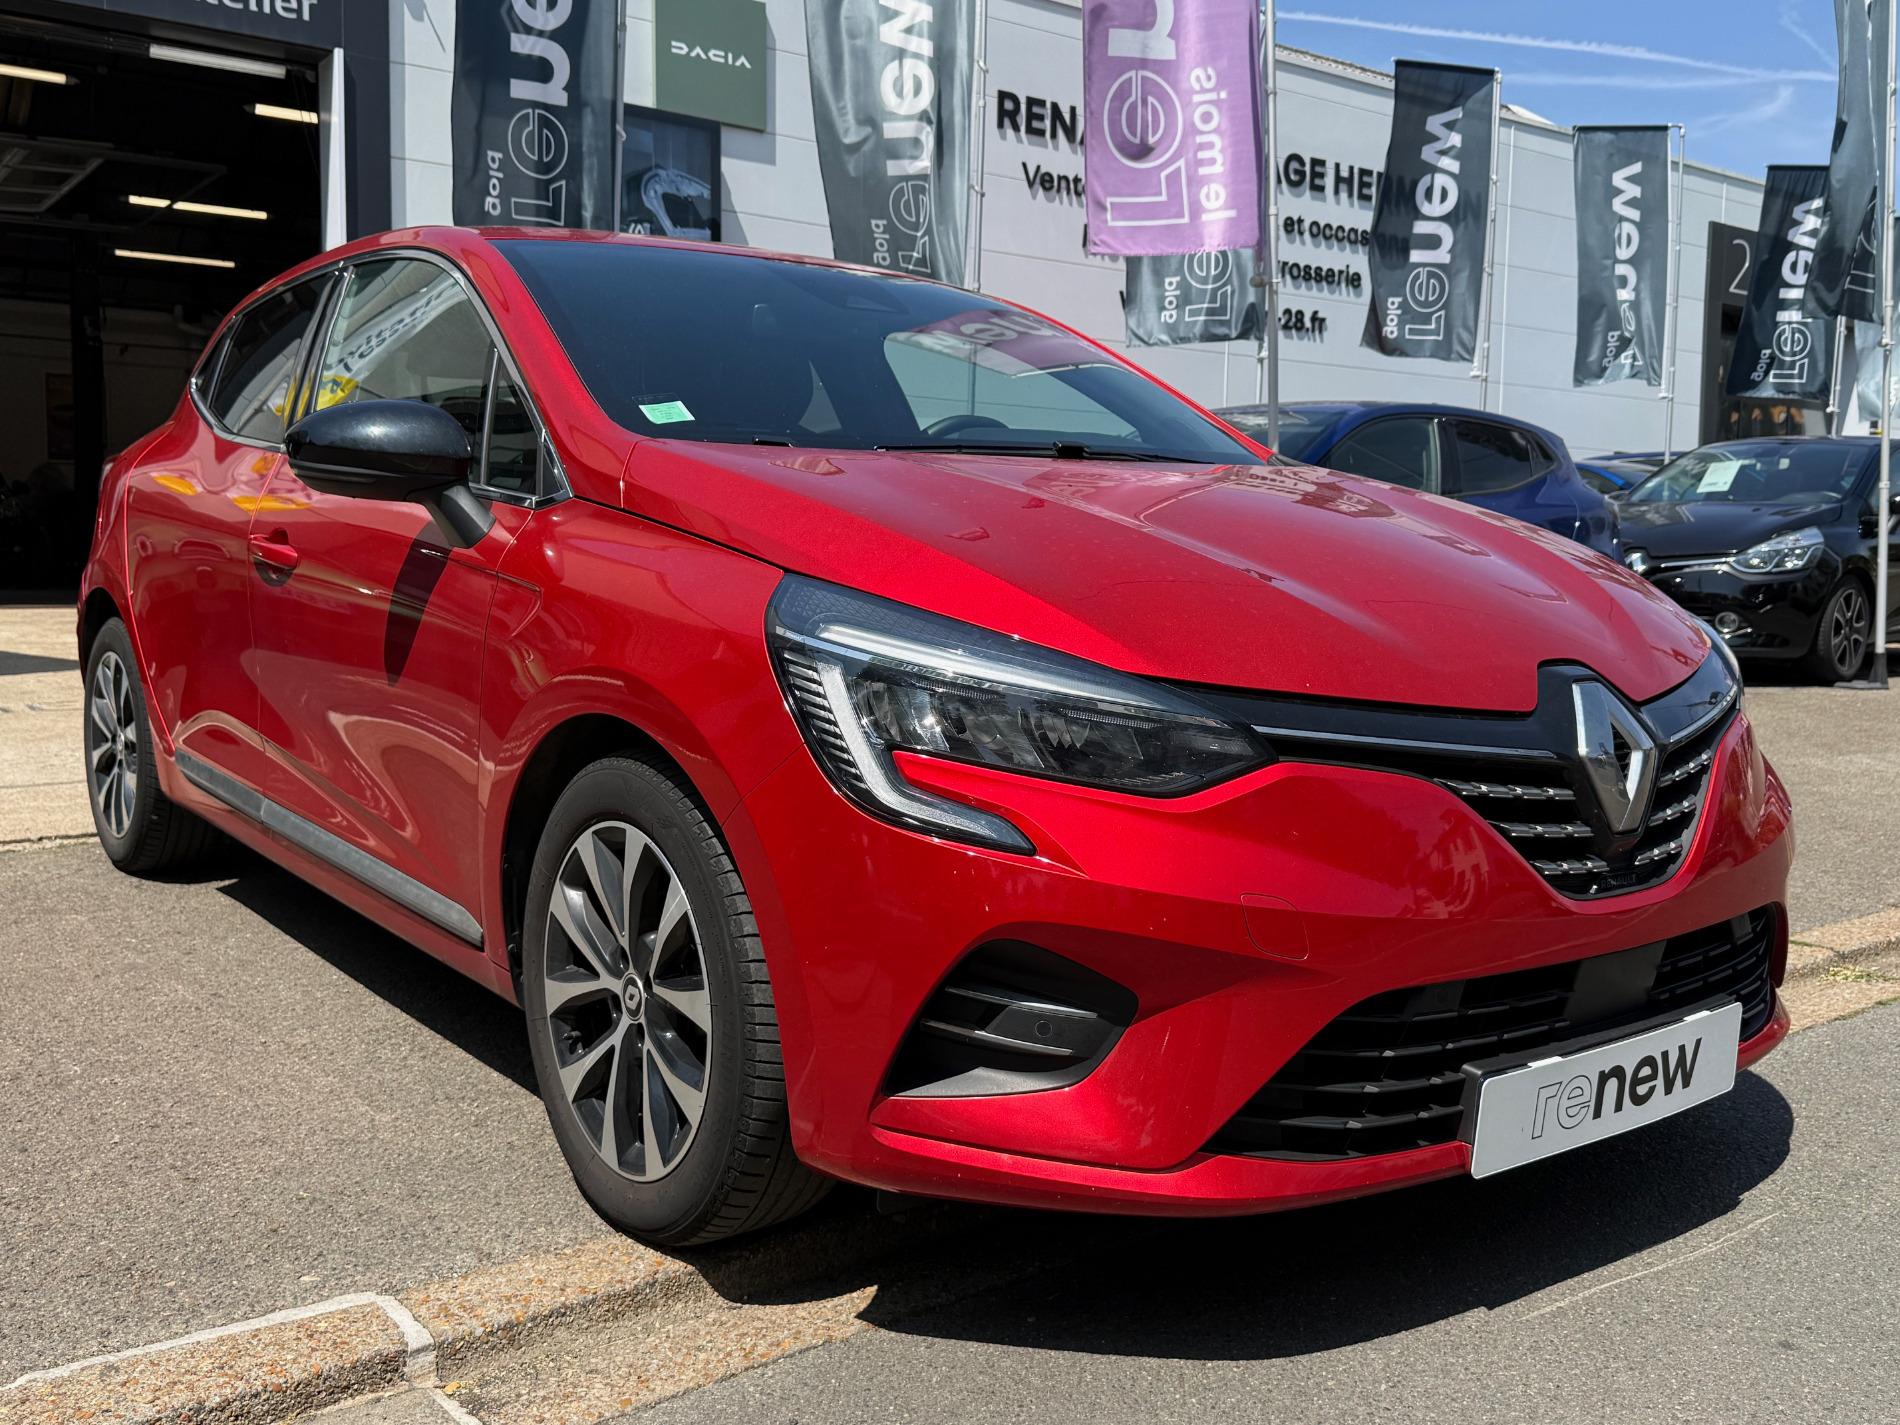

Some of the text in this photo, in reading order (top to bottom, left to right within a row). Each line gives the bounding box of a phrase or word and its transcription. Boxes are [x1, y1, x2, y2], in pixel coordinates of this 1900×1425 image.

[671, 41, 751, 69] DACIA
[997, 89, 1086, 146] REN
[1022, 161, 1085, 196] Vent
[1283, 215, 1304, 237] et
[1531, 1037, 1703, 1140] renew
